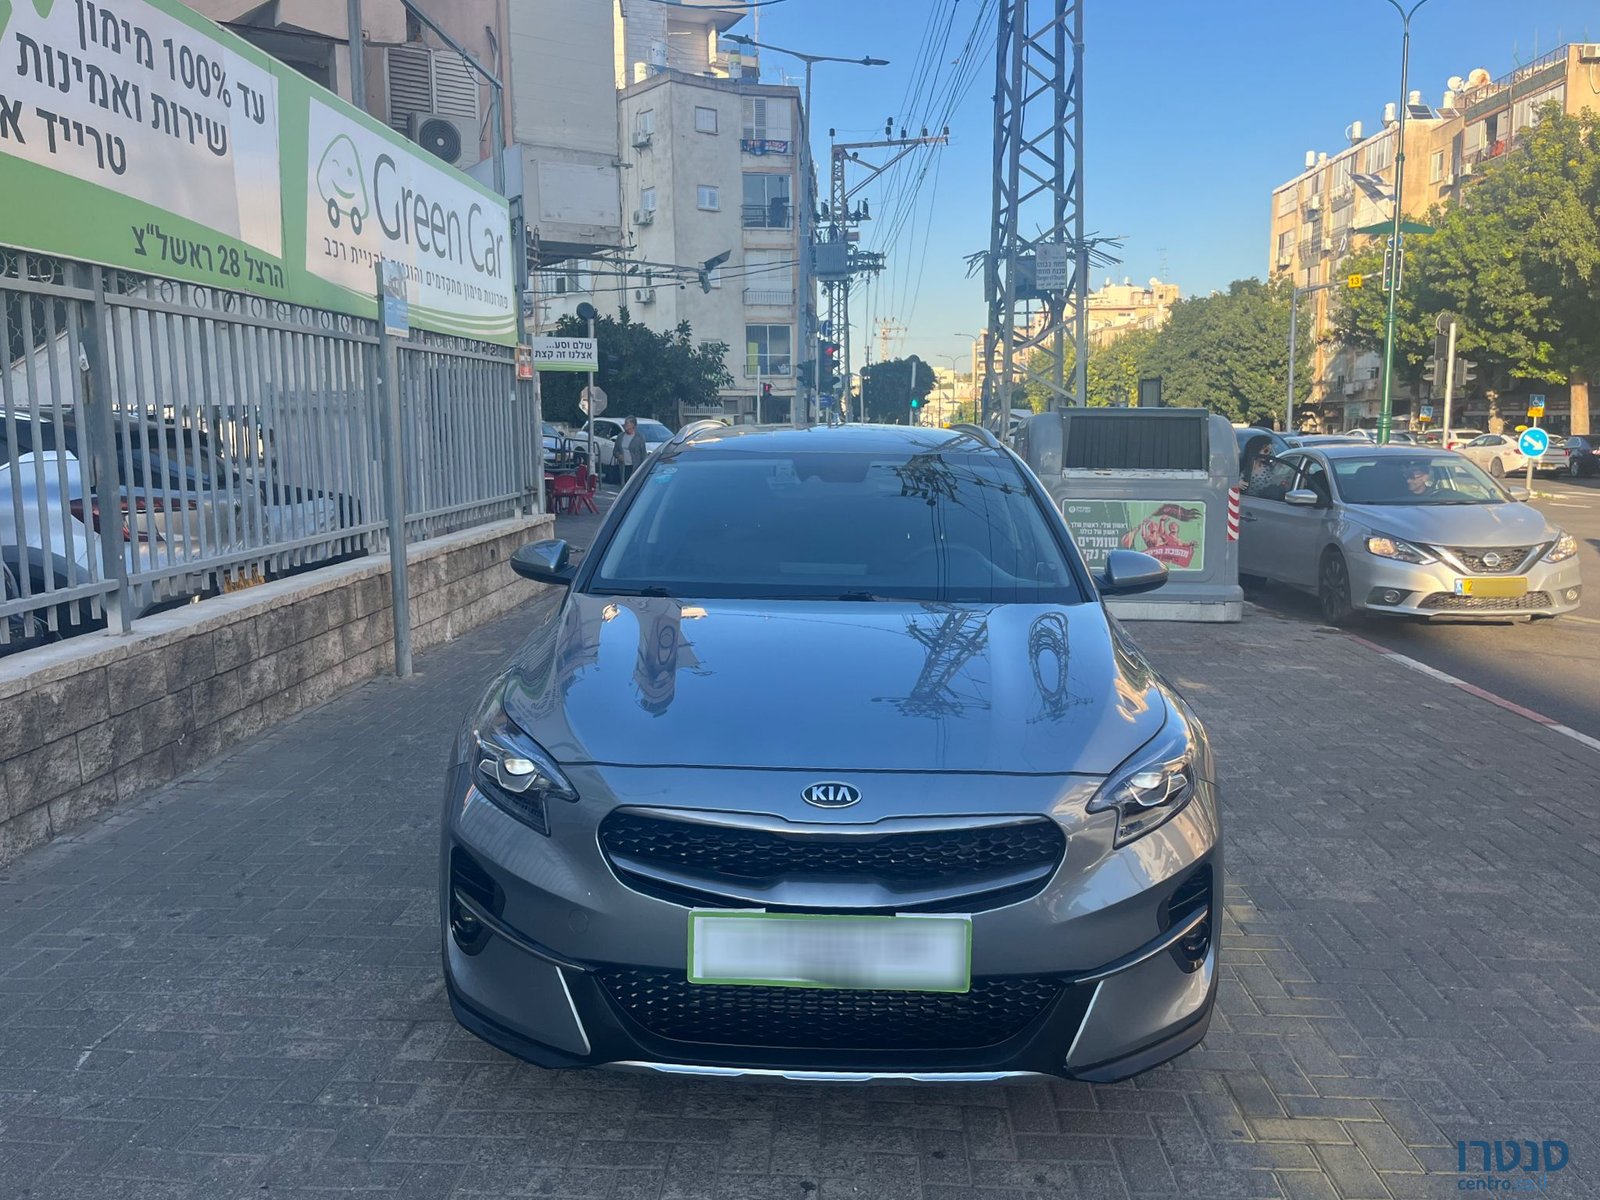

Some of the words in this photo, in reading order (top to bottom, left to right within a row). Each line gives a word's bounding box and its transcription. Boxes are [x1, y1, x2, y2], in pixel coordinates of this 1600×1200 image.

[74, 0, 154, 71] מימון
[16, 32, 142, 123] ואמינות
[163, 38, 232, 108] 100%
[237, 81, 265, 125] עד
[36, 107, 127, 175] טרייד
[150, 92, 227, 157] שירות
[374, 153, 463, 264] Green
[467, 203, 503, 279] Car
[217, 244, 241, 278] 28
[324, 237, 346, 261] רכב
[244, 250, 284, 289] הרצל
[426, 271, 462, 296] מתקדמים
[463, 283, 482, 301] מימון
[534, 350, 554, 360] קצת
[568, 350, 592, 359] אצלנו
[572, 340, 592, 349] שלם
[1077, 536, 1118, 547] שומרים
[812, 786, 852, 802] KIA
